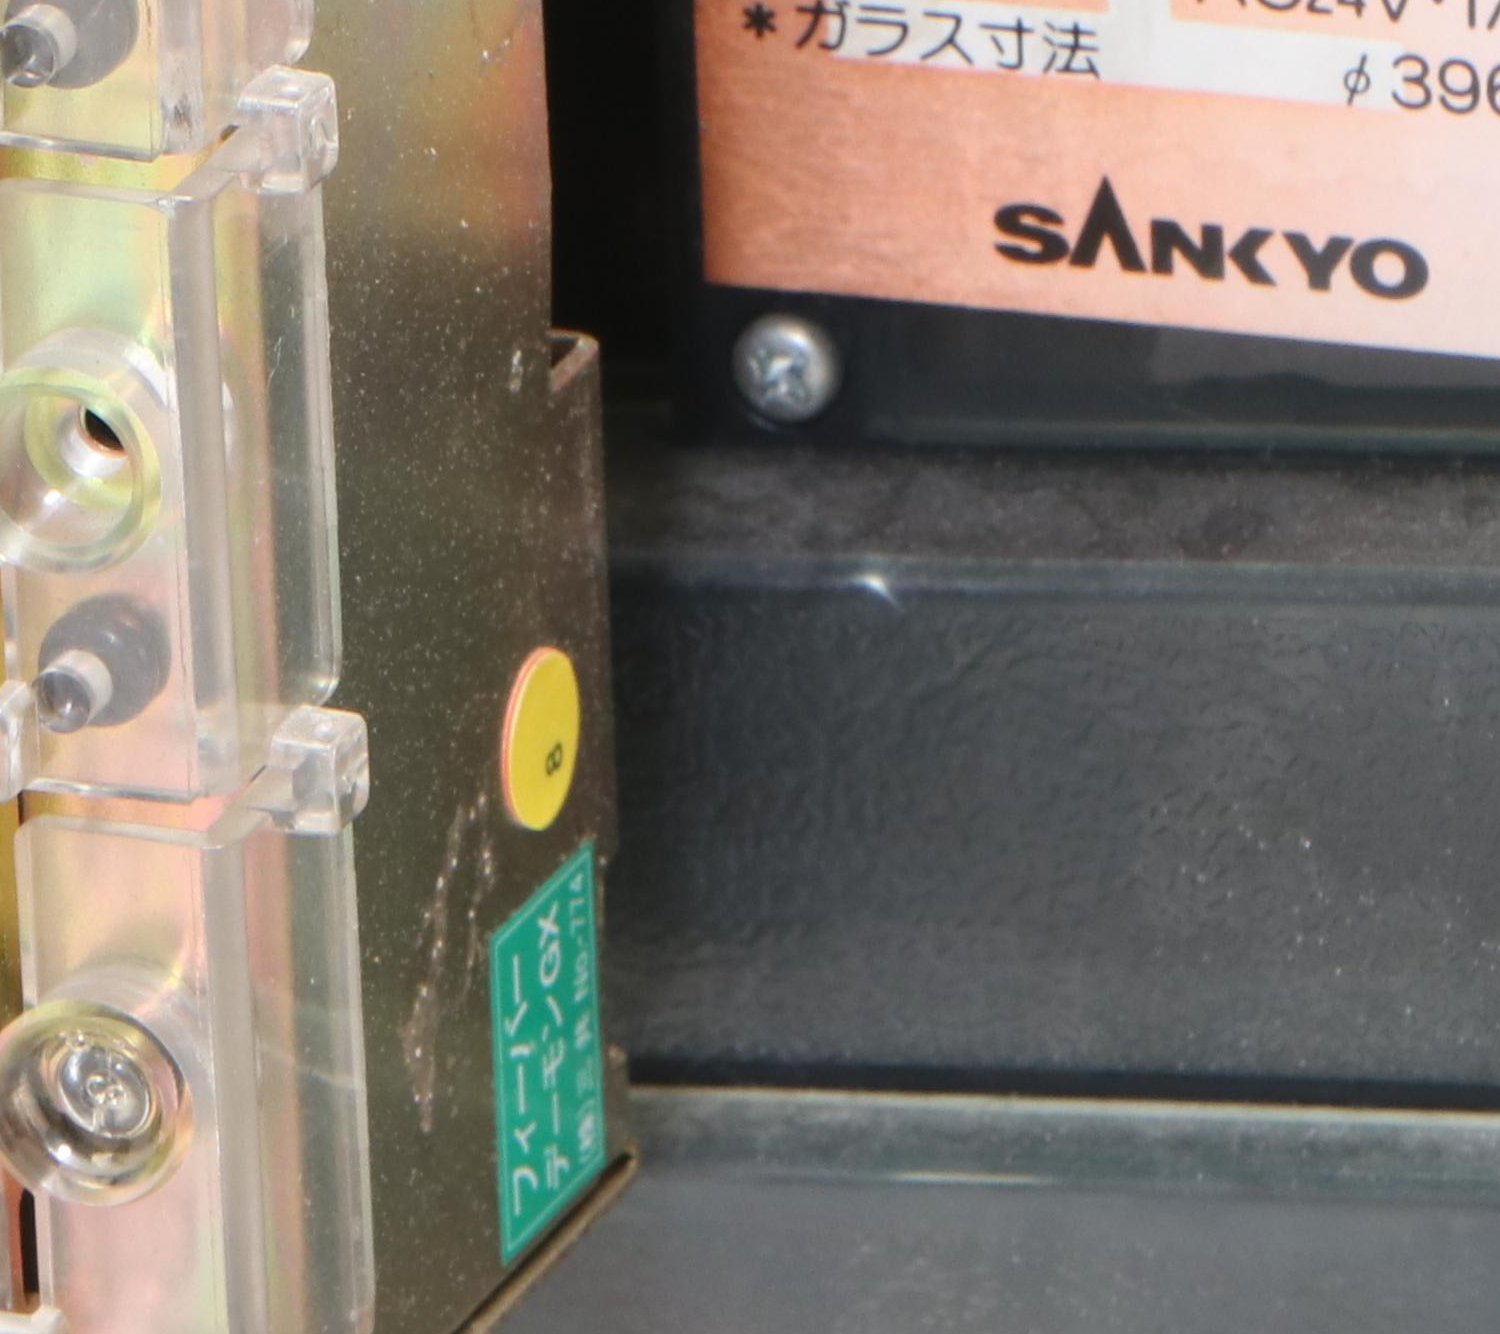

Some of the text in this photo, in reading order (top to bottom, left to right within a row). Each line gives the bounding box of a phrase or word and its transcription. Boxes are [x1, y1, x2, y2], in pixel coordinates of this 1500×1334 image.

[795, 0, 1102, 79] ガラス寸法
[994, 176, 1430, 302] SANKYO
[511, 953, 540, 1217] フィーバー
[537, 899, 571, 1193] デーモンGX
